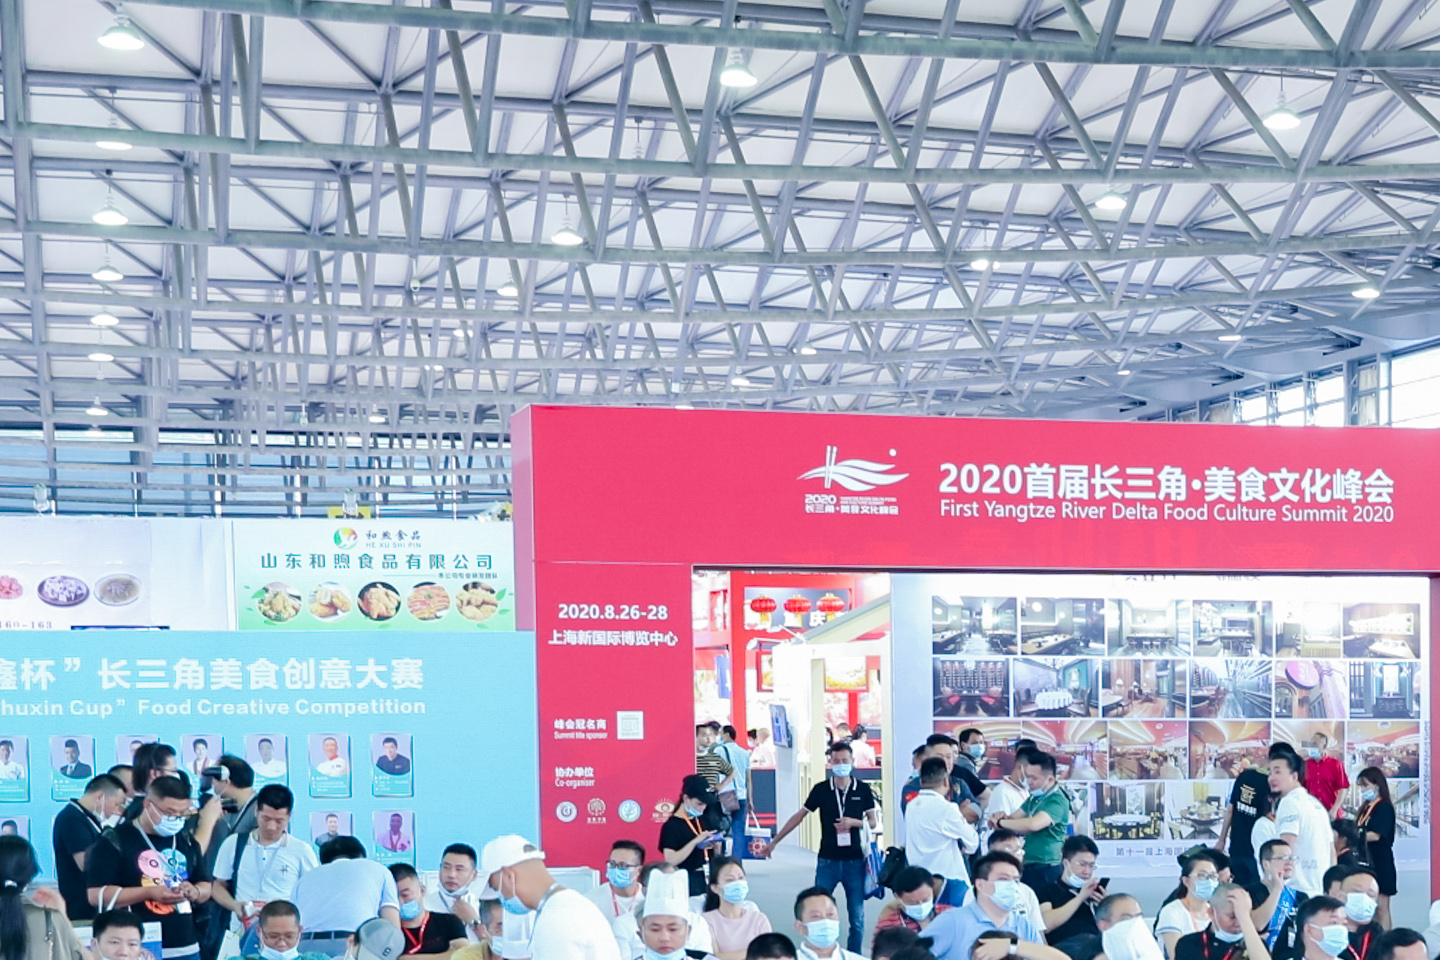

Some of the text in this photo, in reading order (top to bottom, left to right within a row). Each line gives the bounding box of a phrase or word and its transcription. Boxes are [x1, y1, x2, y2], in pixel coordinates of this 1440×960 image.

[938, 462, 1395, 504] 2020首届长三角·美食文化峰会
[940, 499, 1394, 522] First Yangtze River Delta Food Culture Summit 2020
[261, 553, 492, 570] 山东和煦食品有限公司
[558, 604, 668, 620] 2020.8.26-28
[548, 629, 678, 646] 上海新国际博览中心
[138, 699, 191, 715] Food
[197, 699, 289, 715] Creative
[295, 699, 426, 718] Competition
[554, 731, 575, 739] Summit
[586, 731, 608, 740] sponsor
[555, 766, 595, 778] 协办单位
[554, 778, 595, 789] Co-organiser
[1116, 847, 1188, 857] 第十一届上海国
